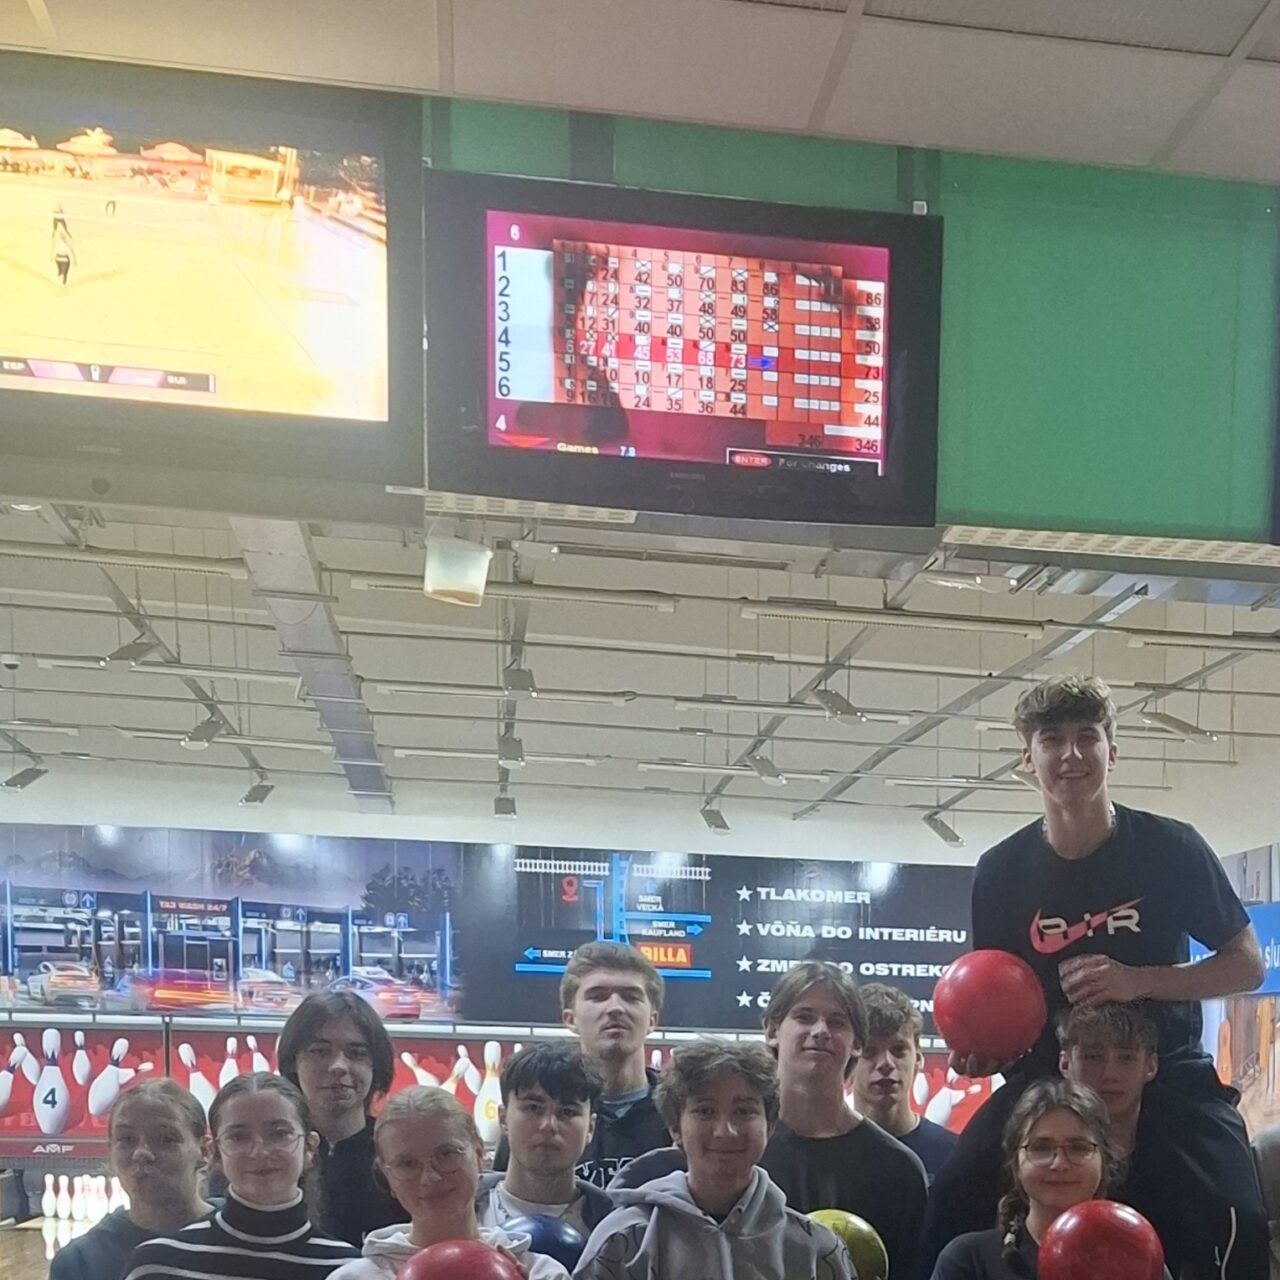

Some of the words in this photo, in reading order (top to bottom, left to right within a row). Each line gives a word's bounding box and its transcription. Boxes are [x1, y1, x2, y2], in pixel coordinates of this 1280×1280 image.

[509, 224, 520, 240] 6
[631, 249, 638, 258] 4
[663, 252, 670, 262] 5
[727, 258, 733, 267] 7
[497, 250, 507, 272] 1
[634, 272, 650, 285] 42
[667, 274, 683, 287] 50
[699, 277, 715, 290] 70
[731, 280, 746, 293] 83
[762, 283, 779, 295] 86
[866, 292, 881, 305] 86
[498, 275, 511, 297] 2
[602, 294, 619, 306] 24
[634, 296, 650, 309] 32
[667, 299, 682, 312] 37
[698, 302, 714, 315] 48
[730, 305, 746, 318] 49
[762, 308, 778, 321] 58
[498, 301, 510, 322] 3
[580, 318, 596, 330] 12
[602, 318, 616, 331] 31
[634, 322, 650, 334] 40
[667, 324, 682, 337] 40
[698, 327, 714, 340] 50
[730, 330, 746, 343] 50
[865, 342, 881, 355] 50
[498, 326, 511, 347] 4
[579, 340, 596, 355] 27
[601, 342, 616, 356] 41
[633, 346, 650, 360] 45
[666, 349, 682, 362] 53
[698, 350, 714, 365] 68
[730, 354, 746, 368] 73
[865, 366, 880, 380] 73
[498, 351, 511, 372] 5
[634, 371, 650, 384] 10
[666, 374, 682, 387] 17
[698, 377, 714, 390] 18
[730, 379, 746, 392] 25
[864, 390, 880, 404] 25
[498, 376, 511, 397] 6
[634, 396, 650, 408] 24
[666, 398, 682, 411] 35
[698, 401, 714, 414] 36
[730, 404, 746, 416] 44
[863, 415, 880, 428] 44
[495, 414, 507, 431] 4
[855, 438, 879, 452] 346
[556, 442, 599, 454] Games
[757, 887, 871, 904] TLAKOMER
[641, 928, 686, 938] KAUFLAND
[756, 920, 816, 938] VÔŇA
[821, 926, 852, 939] DO
[858, 926, 967, 943] INTERIÉRU
[1039, 908, 1142, 937] AIR
[42, 1088, 58, 1109] 4
[483, 1101, 498, 1120] 6
[32, 1144, 75, 1154] AMF
